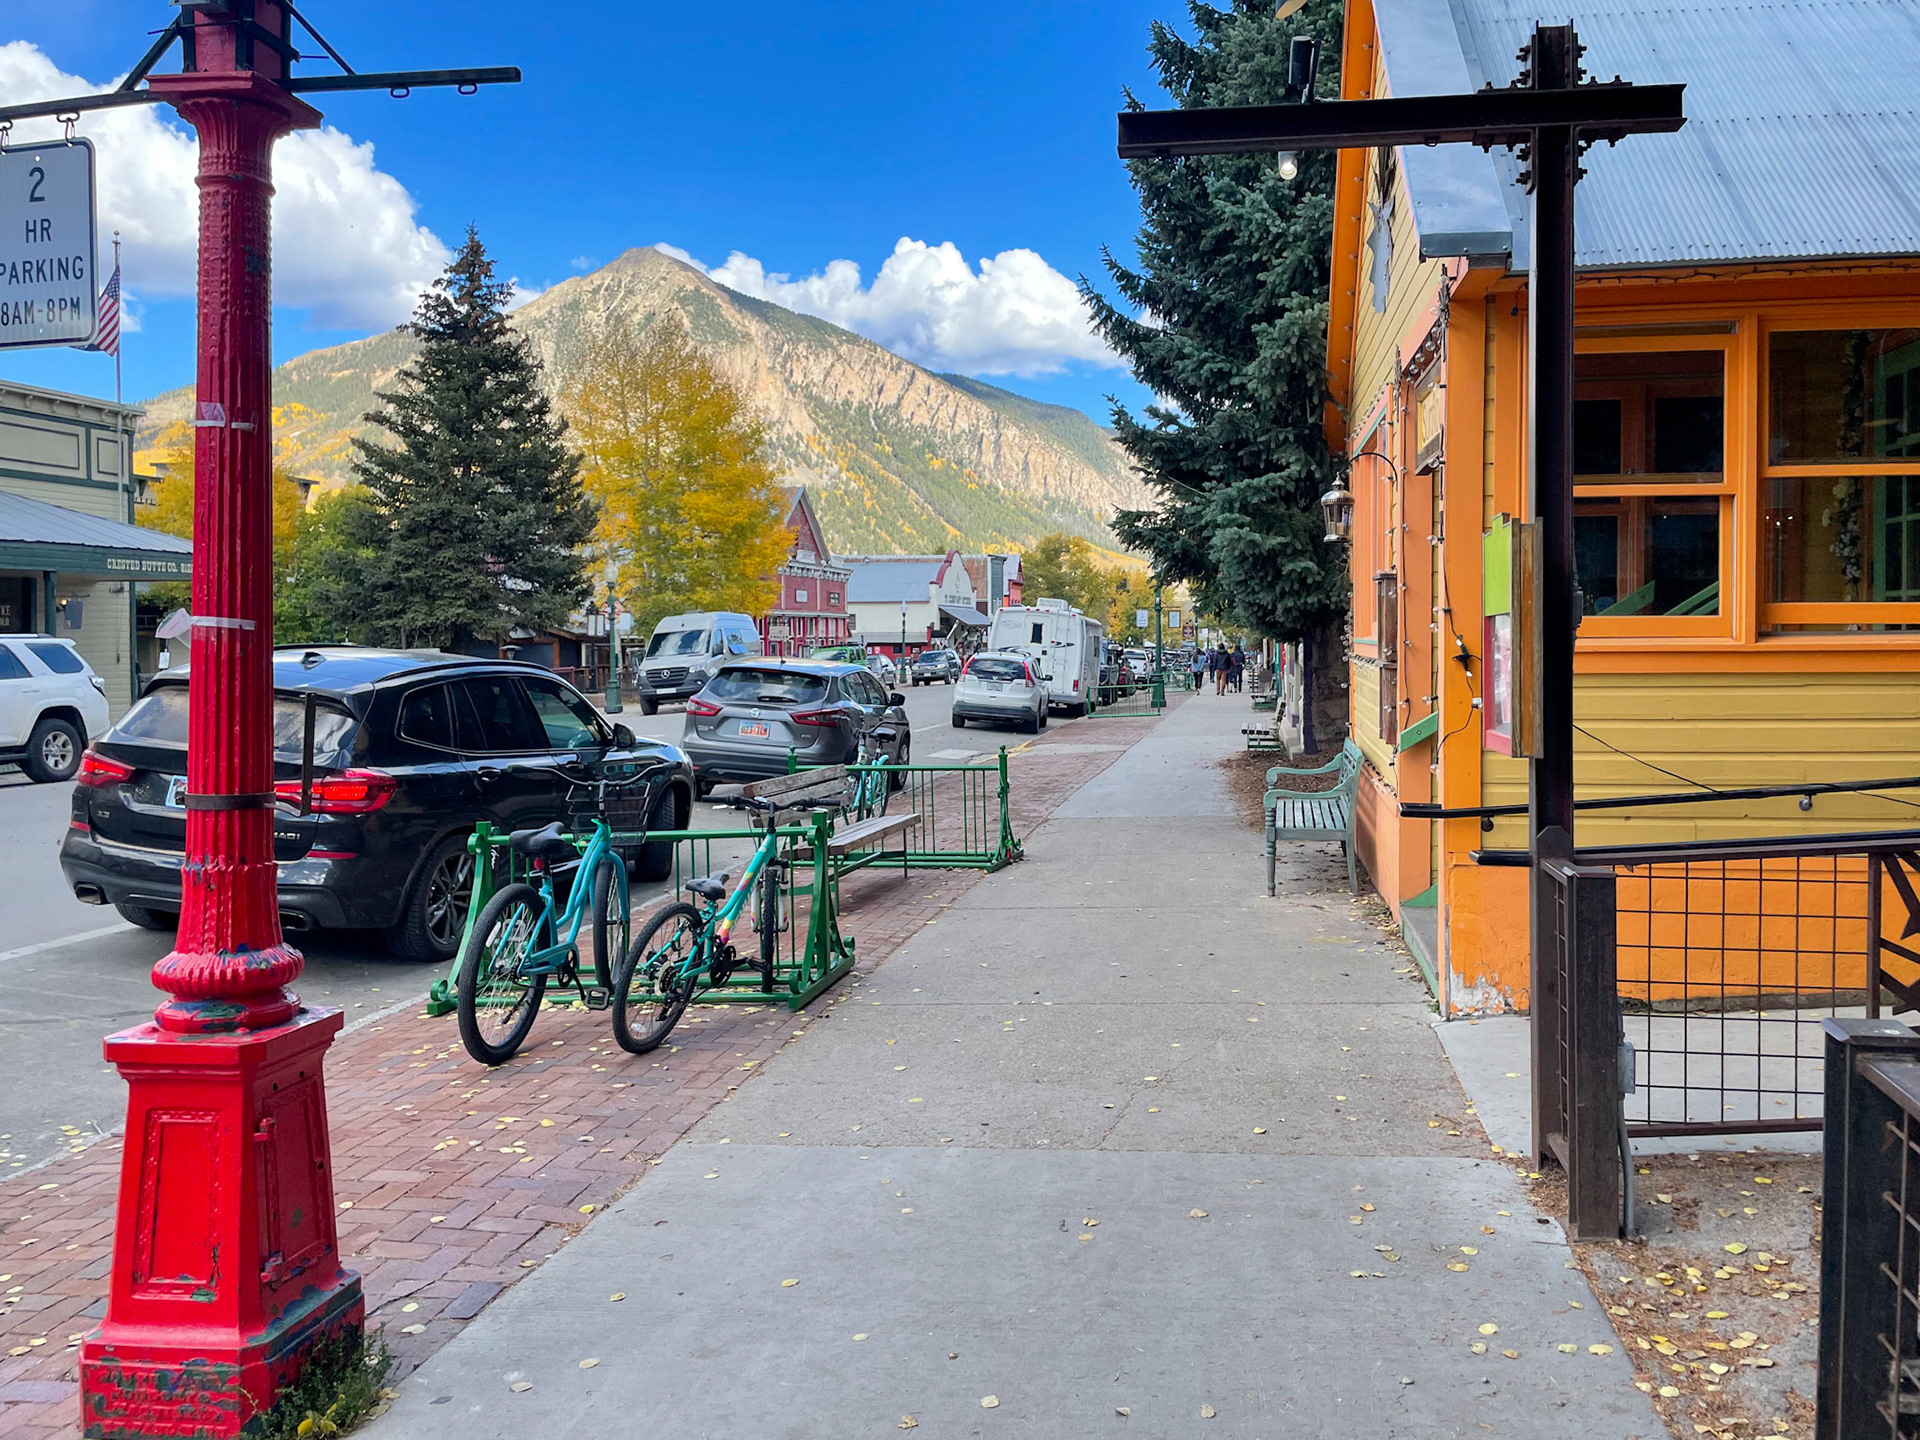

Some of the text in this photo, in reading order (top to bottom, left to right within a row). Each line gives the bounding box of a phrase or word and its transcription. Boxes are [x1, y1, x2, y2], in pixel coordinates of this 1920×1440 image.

[29, 167, 45, 202] 2
[25, 218, 51, 243] HR
[0, 255, 84, 286] PARKING
[1, 297, 80, 326] 8AM-8PM
[107, 559, 140, 570] CRESTED
[142, 561, 166, 572] BUTTE
